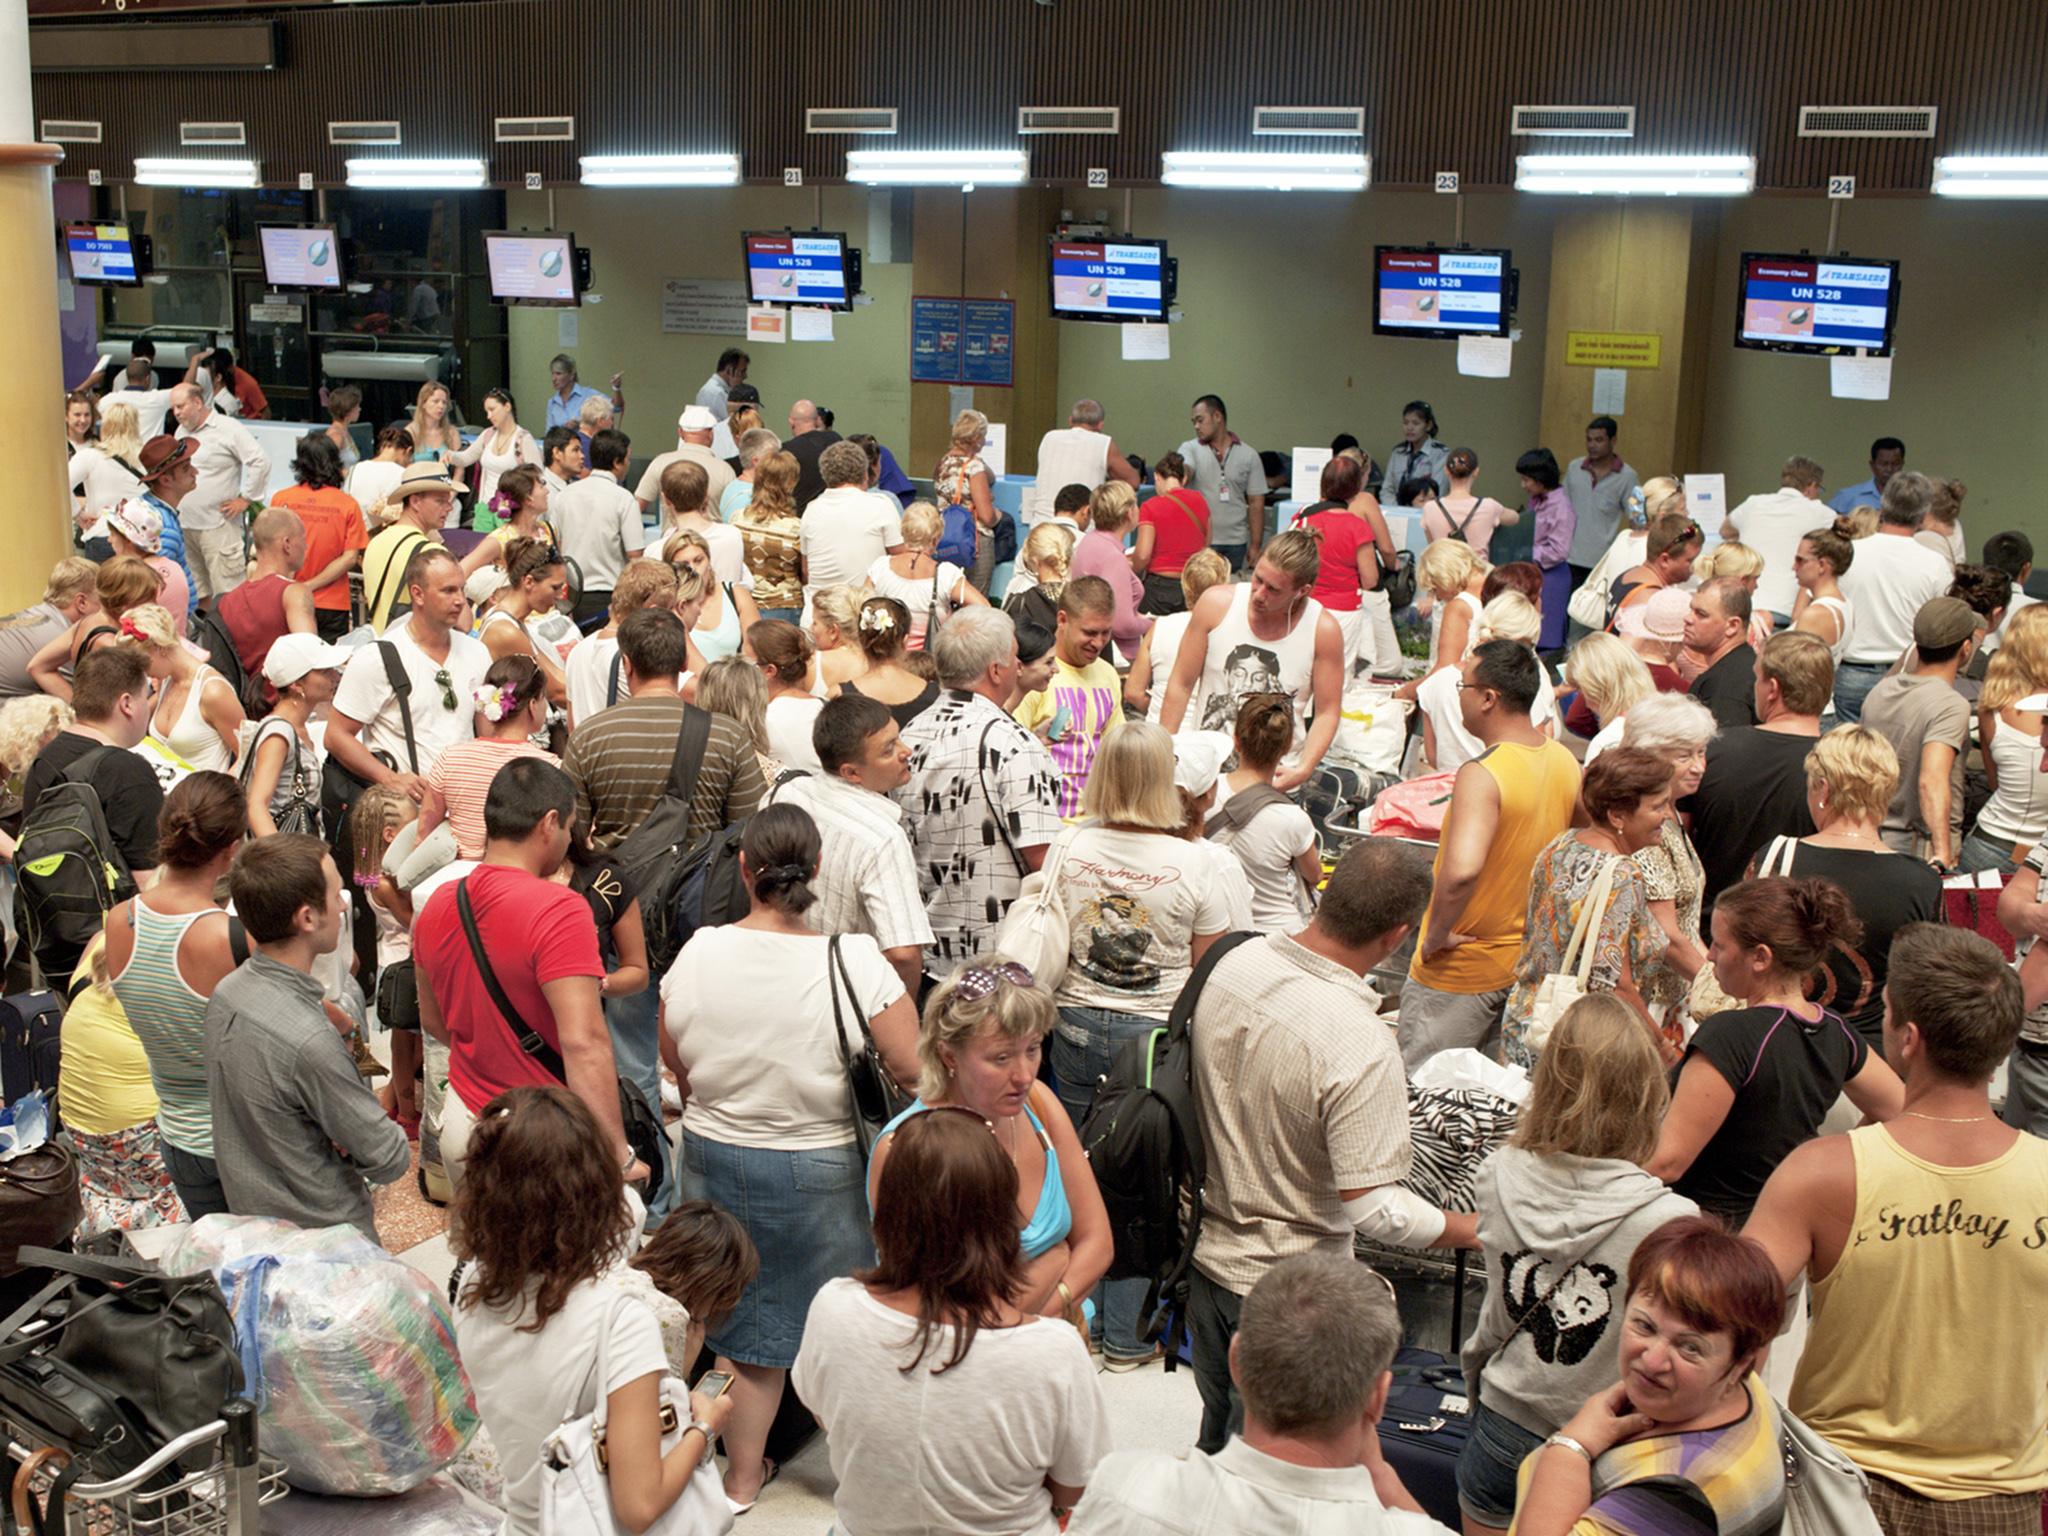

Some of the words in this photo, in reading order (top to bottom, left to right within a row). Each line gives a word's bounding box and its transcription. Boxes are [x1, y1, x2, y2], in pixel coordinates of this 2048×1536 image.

[527, 175, 540, 187] 20
[786, 171, 799, 183] 21
[1090, 171, 1105, 184] 22
[1438, 175, 1456, 189] 23
[1831, 180, 1852, 194] 24
[778, 258, 793, 266] UN
[795, 258, 812, 267] 528
[1087, 265, 1104, 274] UN
[1106, 266, 1126, 275] 528
[1757, 268, 1789, 277] Economy
[1790, 269, 1808, 278] Class
[1418, 276, 1437, 287] UN
[1440, 278, 1462, 288] 528
[1829, 271, 1887, 283] TRANSAERO
[1791, 287, 1813, 299] UN
[1816, 289, 1842, 300] 528
[1062, 857, 1182, 892] Harmony
[1879, 1198, 2010, 1250] Fatboy
